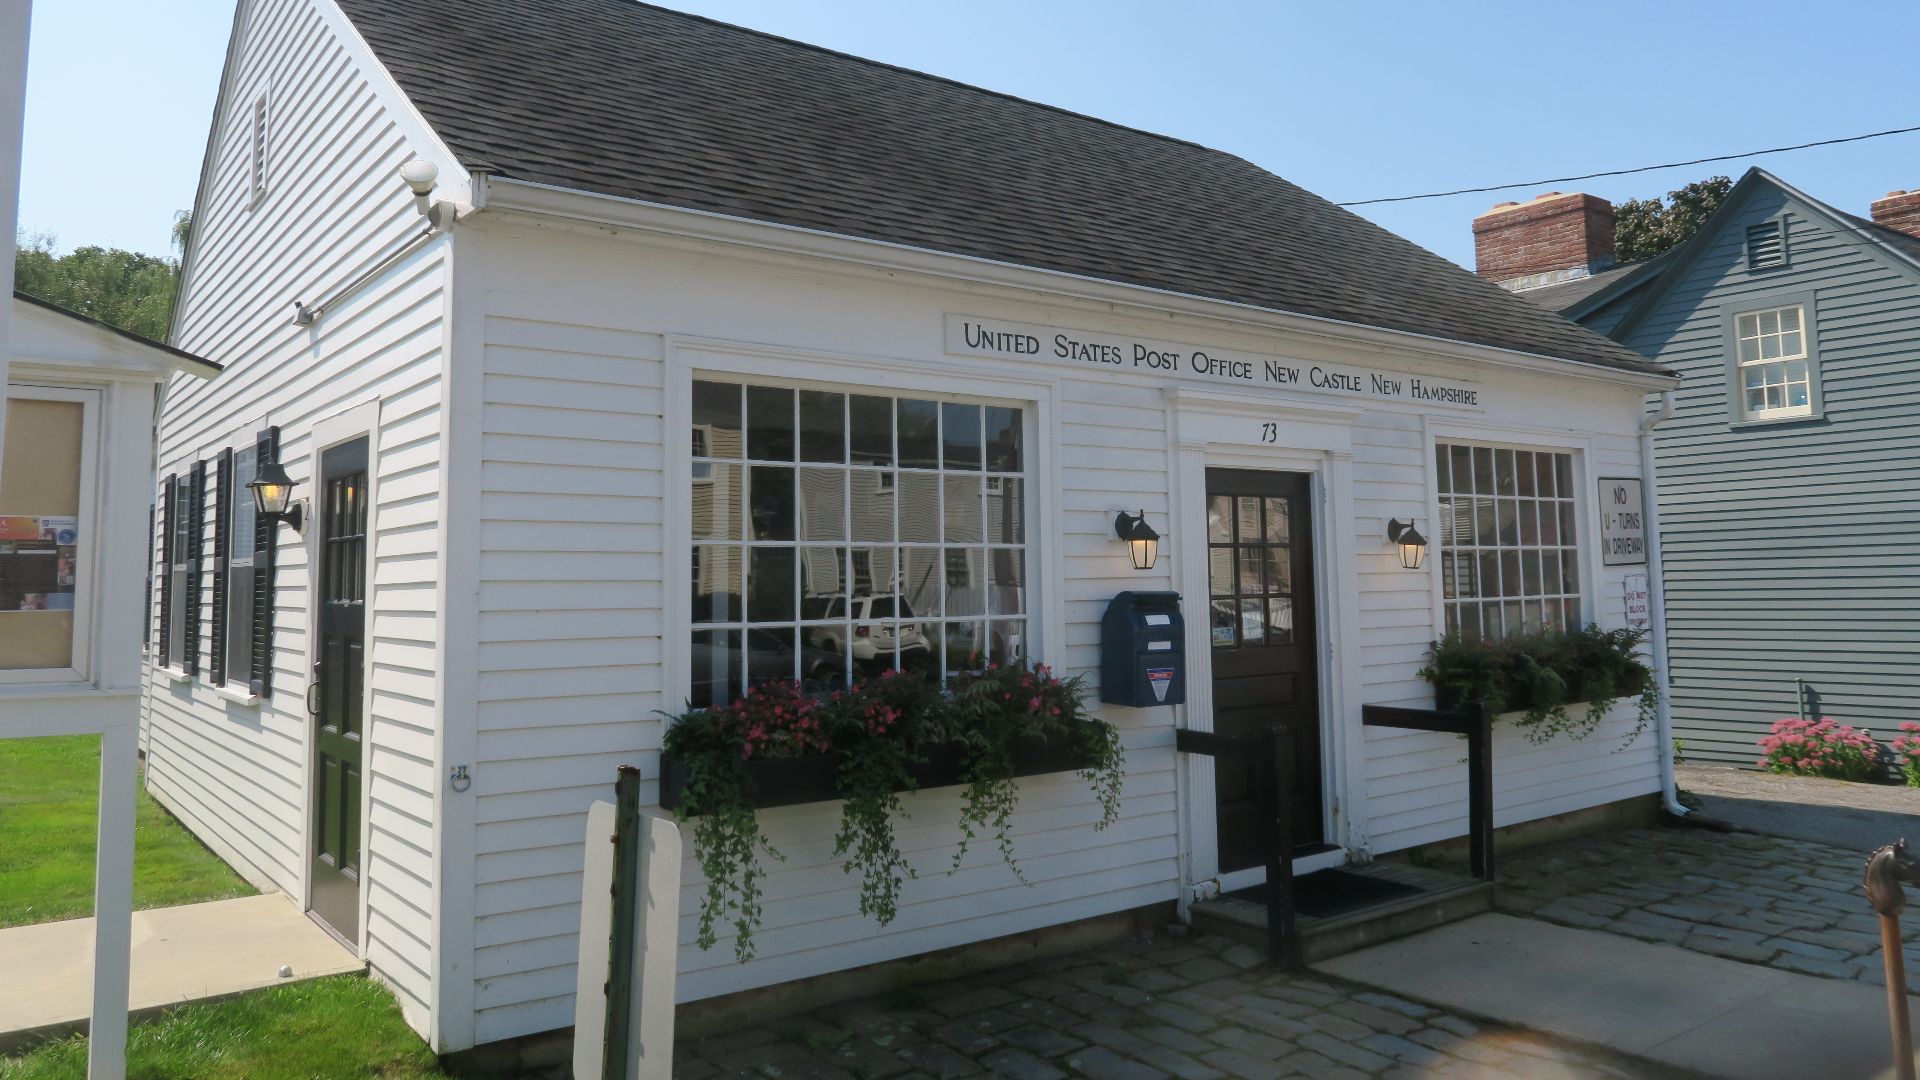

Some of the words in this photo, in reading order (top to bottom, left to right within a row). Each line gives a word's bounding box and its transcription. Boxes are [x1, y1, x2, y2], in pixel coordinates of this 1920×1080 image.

[963, 322, 1040, 355] UNITED
[1054, 334, 1122, 365] STATES
[1133, 343, 1180, 371] POST
[1191, 351, 1253, 380] OFFICE
[1264, 360, 1299, 385] NEW
[1309, 366, 1362, 392] CASTLE
[1371, 373, 1402, 396] NEW
[1411, 378, 1478, 406] HAMPSHIRE
[1261, 422, 1278, 443] 73
[1613, 487, 1627, 505] NO
[1618, 512, 1640, 530] TURNS
[1603, 537, 1611, 555] IN
[1612, 537, 1643, 555] DRIVEWAY
[1626, 591, 1635, 600] DO
[1636, 591, 1647, 600] NOT
[1629, 604, 1646, 613] BLOCK
